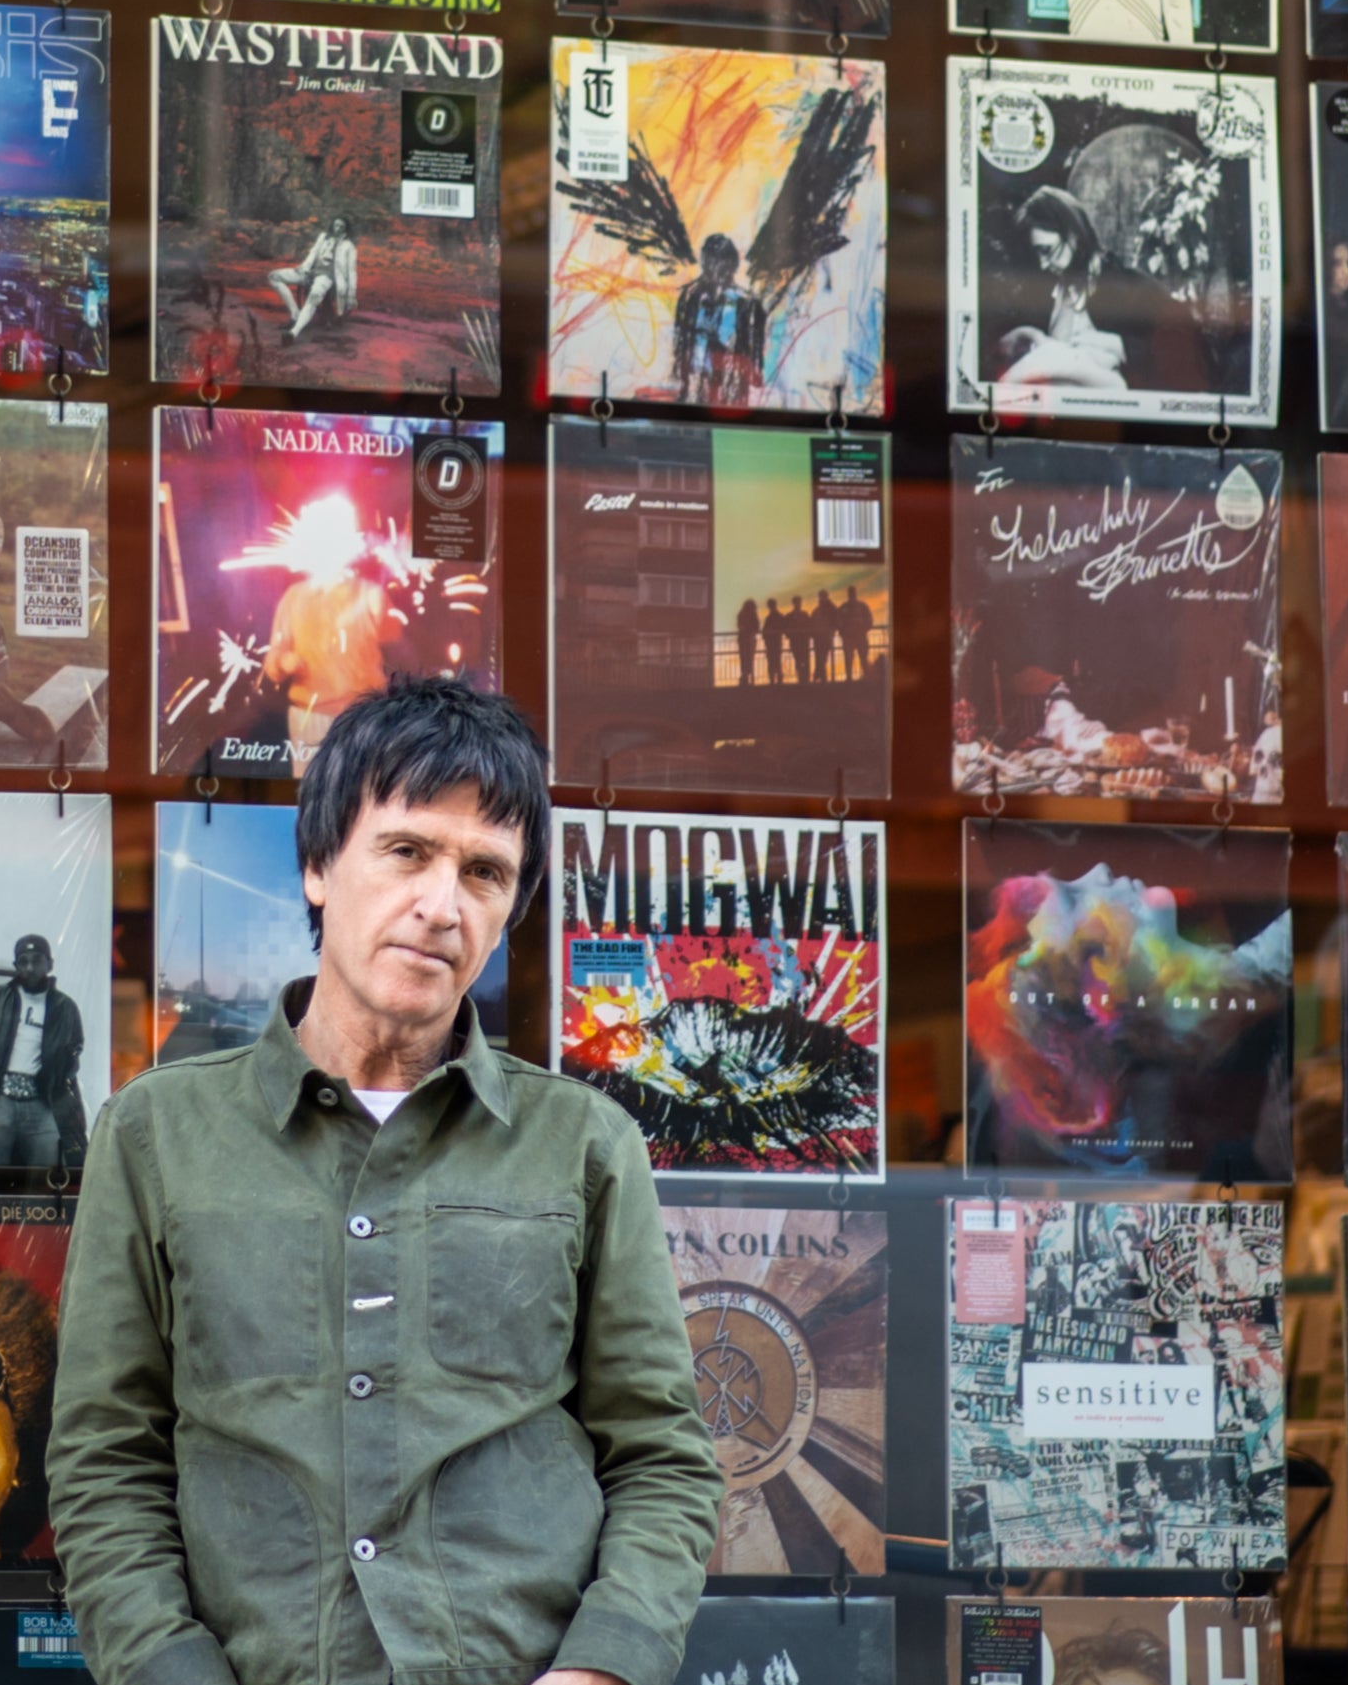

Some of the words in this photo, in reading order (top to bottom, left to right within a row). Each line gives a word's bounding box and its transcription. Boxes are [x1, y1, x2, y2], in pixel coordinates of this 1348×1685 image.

[158, 15, 504, 80] WASTELAND
[296, 75, 321, 93] Jim
[324, 76, 366, 94] Ghedi
[263, 427, 343, 454] NADIA
[347, 431, 405, 458] REID
[24, 535, 82, 549] OCEANSIDE
[27, 596, 80, 608] ANALOG
[55, 617, 82, 628] VINYL
[219, 736, 281, 762] Enter
[562, 822, 879, 942] MOGWAI
[1009, 991, 1055, 1005] OUT
[1082, 993, 1109, 1006] OF
[1137, 995, 1146, 1008] A
[1172, 996, 1256, 1011] DREAM
[717, 1231, 850, 1259] COLLINS
[698, 1291, 751, 1309] SPEAK
[755, 1299, 795, 1338] UNTO
[789, 1343, 814, 1415] NATION
[1037, 1380, 1202, 1406] sensitive
[1166, 1532, 1203, 1550] POP
[23, 1617, 48, 1628] BOB
